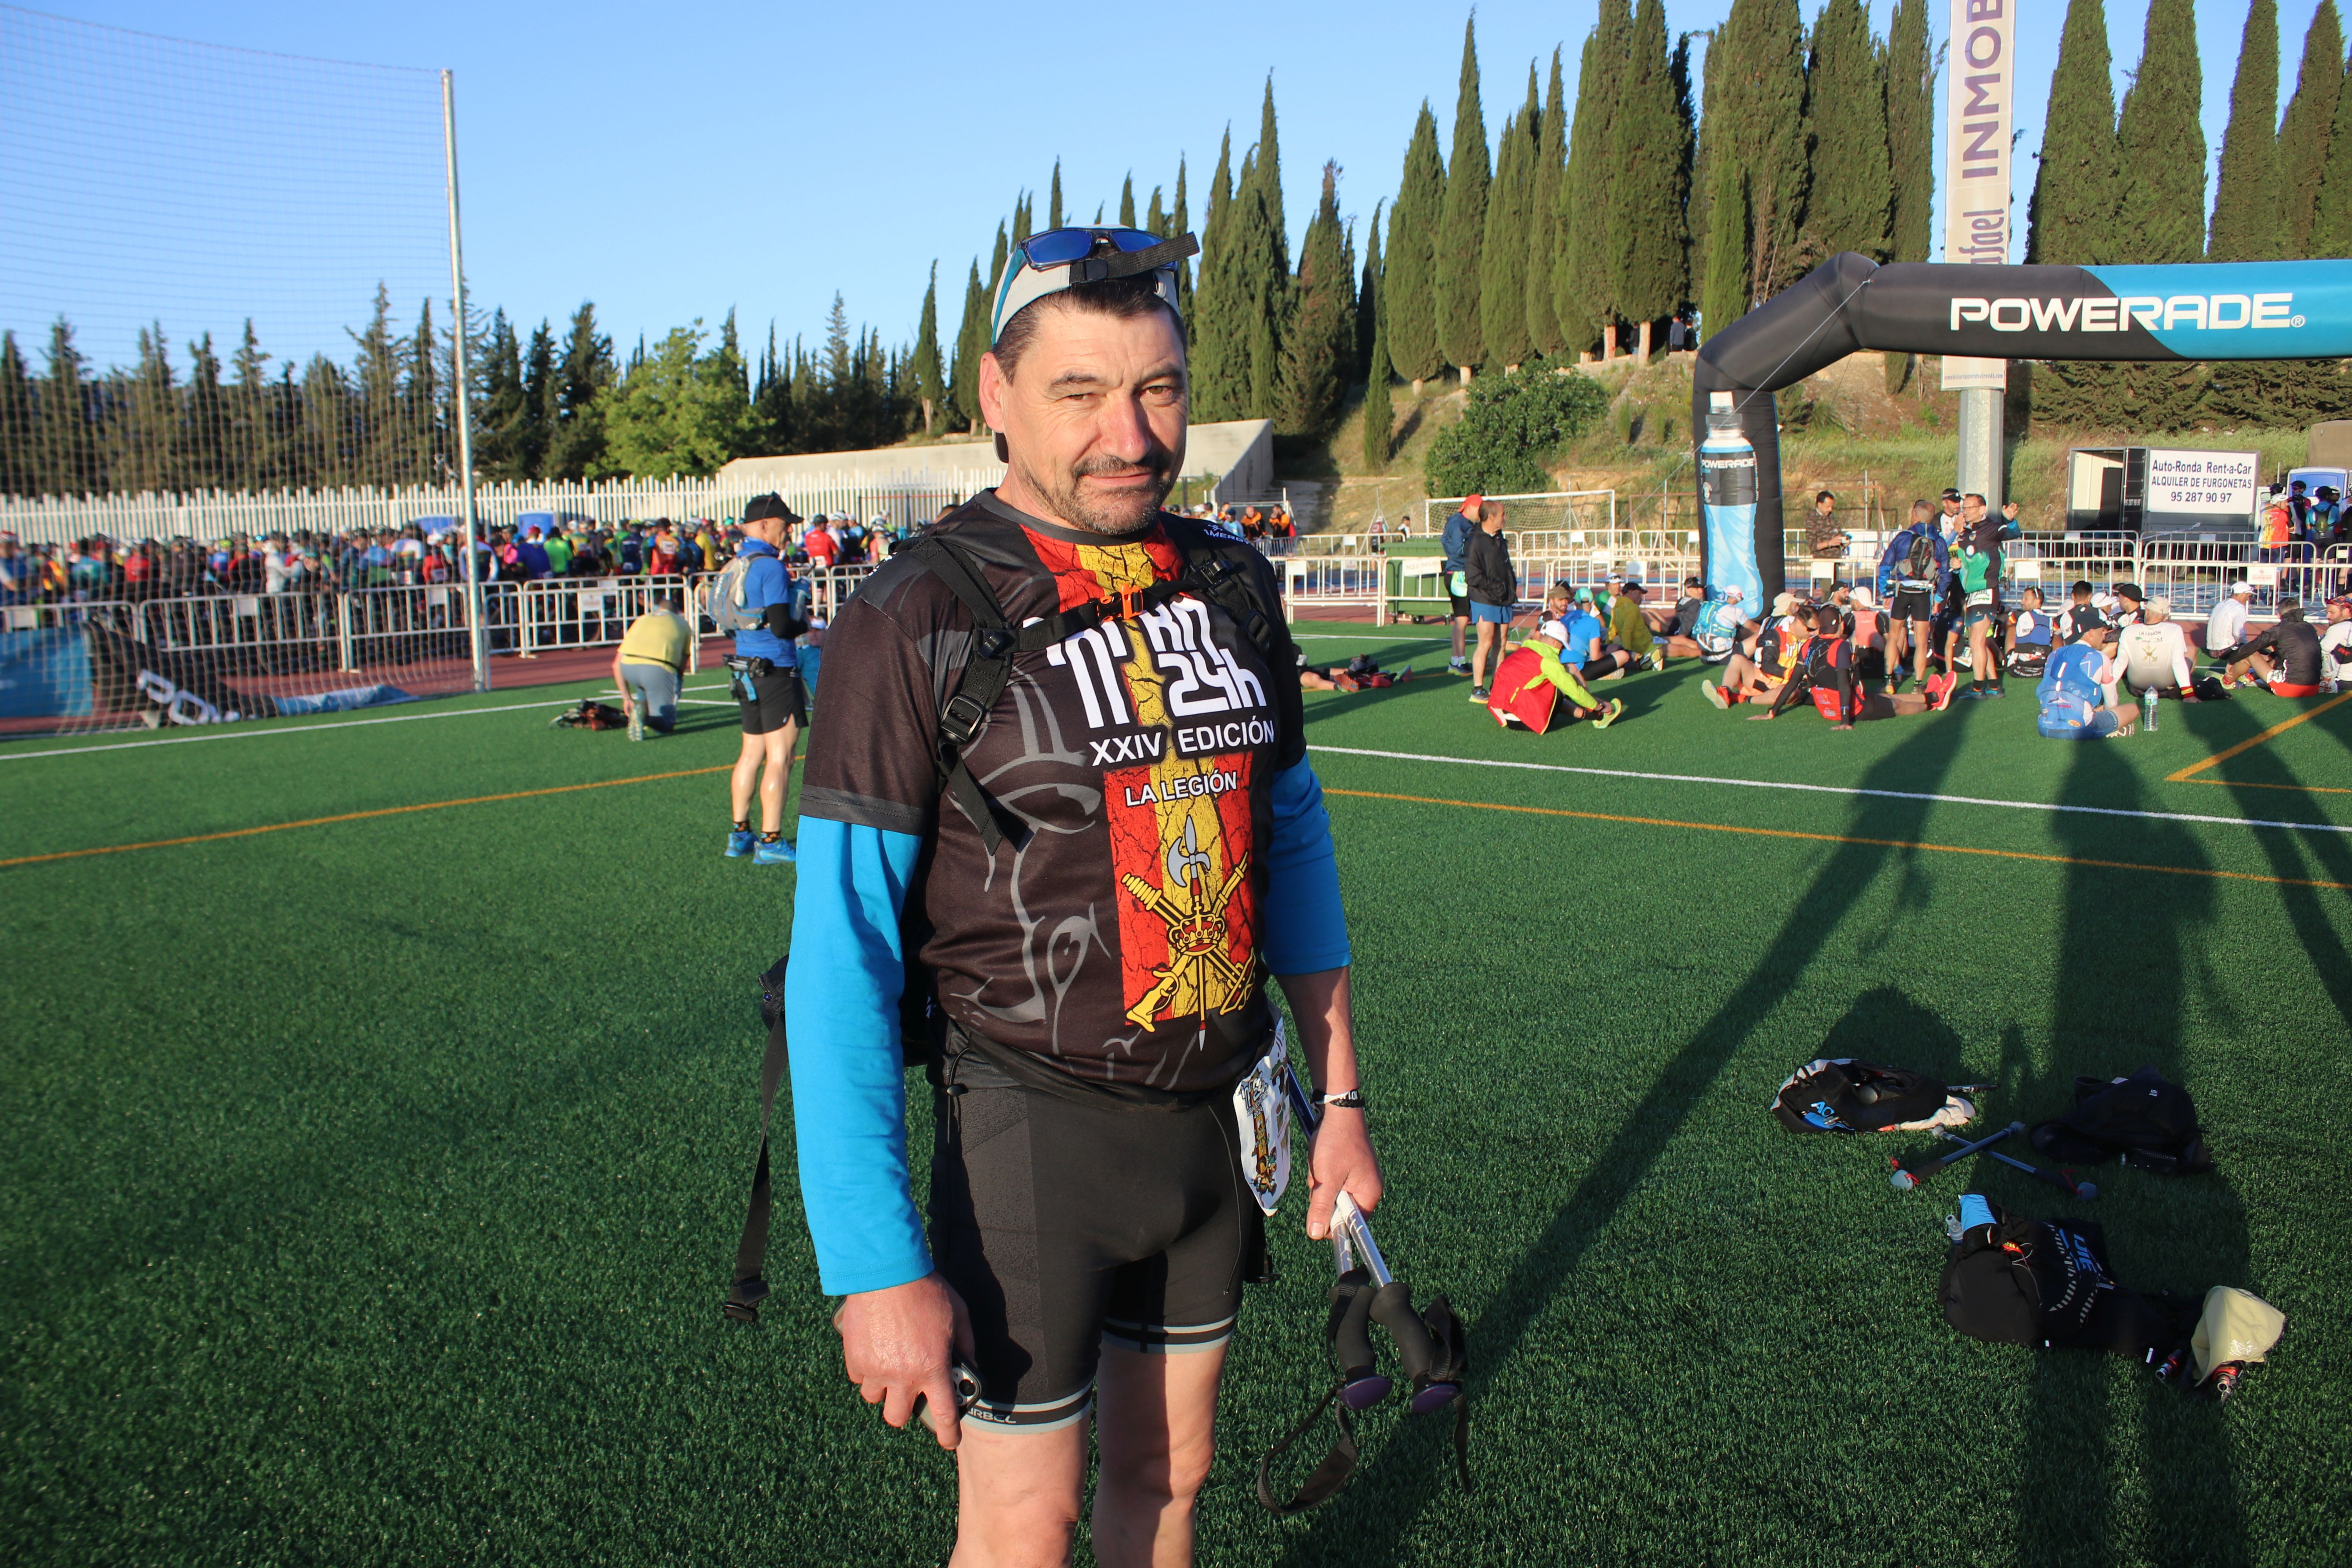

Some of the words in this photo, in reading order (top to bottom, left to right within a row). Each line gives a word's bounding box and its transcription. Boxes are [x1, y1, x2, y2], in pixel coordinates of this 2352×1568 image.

[1701, 458, 1754, 469] POWERADE
[2152, 459, 2201, 473] Auto-Ronda
[2207, 461, 2252, 475] Rent-a-Car
[2151, 475, 2188, 487] ALQUILER
[2190, 477, 2200, 487] DE
[2202, 478, 2252, 489] FURGONETAS
[2171, 492, 2182, 502] 95
[2185, 492, 2203, 502] 287
[2205, 492, 2217, 503] 90
[2220, 493, 2232, 503] 97
[1089, 732, 1161, 767] XXIV
[1178, 715, 1274, 753] EDICIÓN
[1125, 785, 1158, 806] LA
[1161, 769, 1237, 800] LEGIÓN
